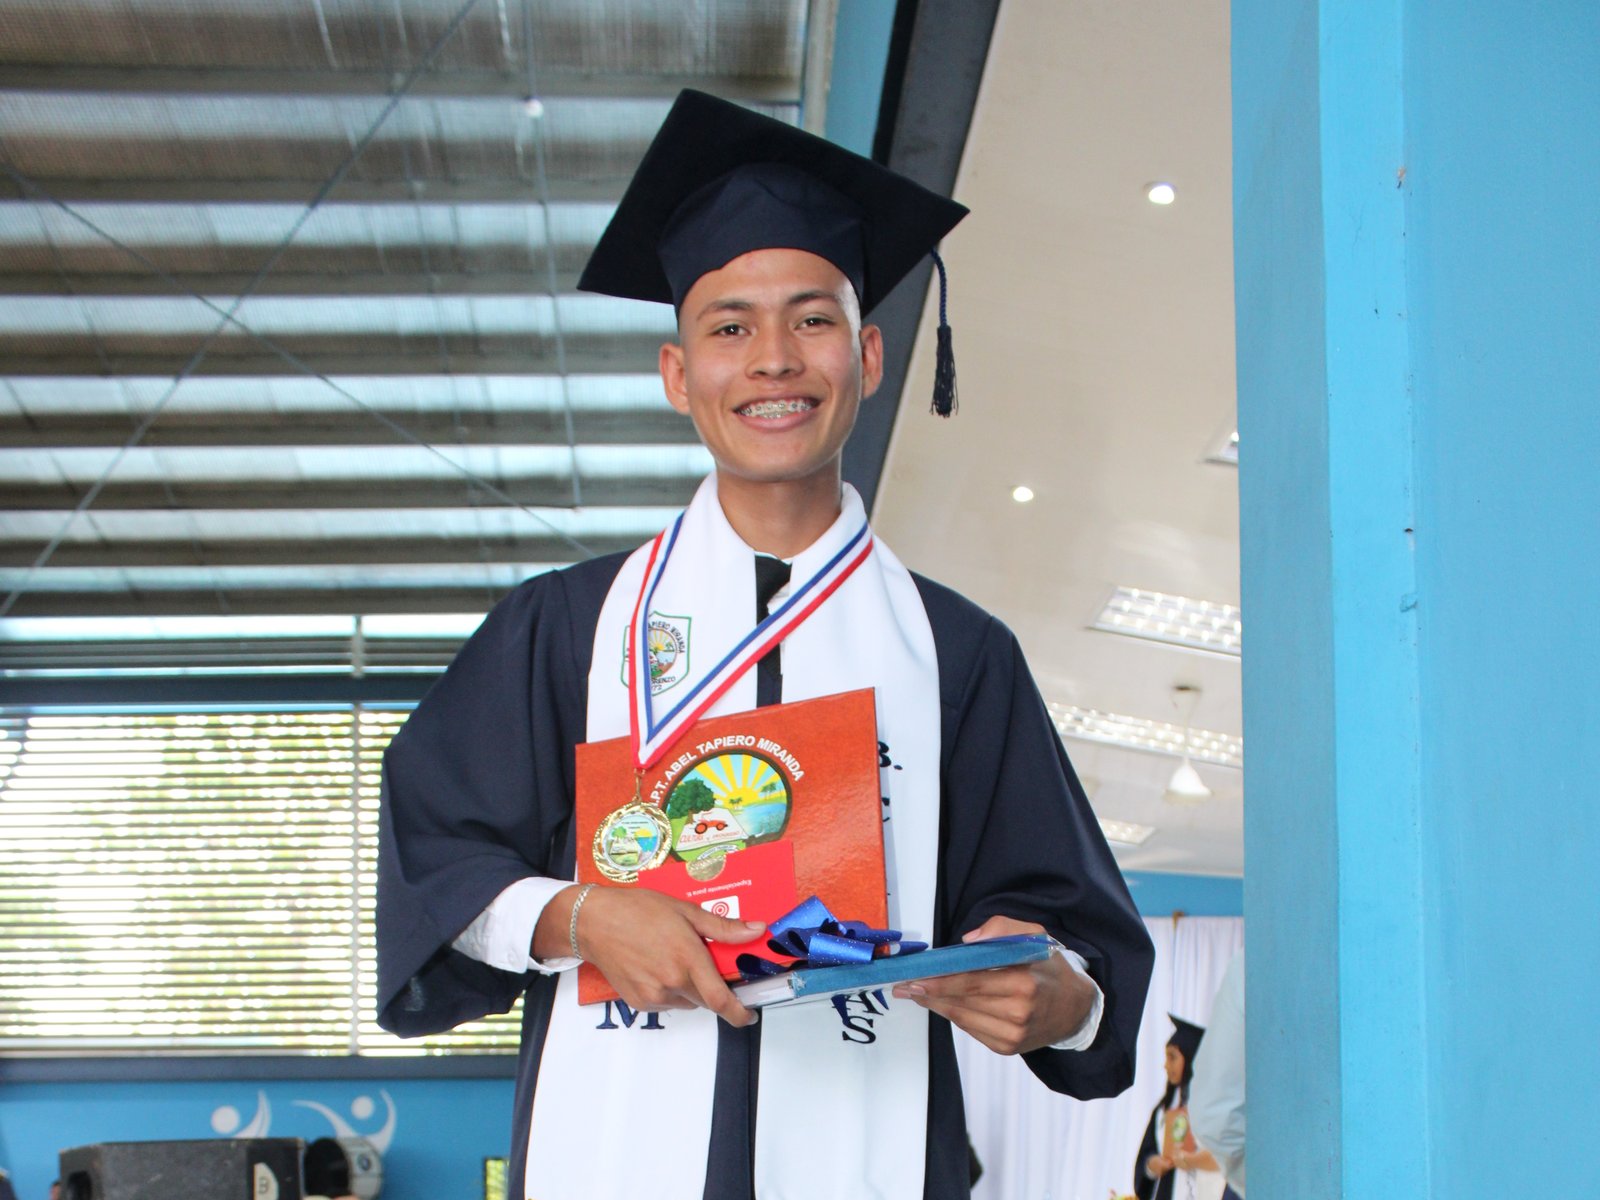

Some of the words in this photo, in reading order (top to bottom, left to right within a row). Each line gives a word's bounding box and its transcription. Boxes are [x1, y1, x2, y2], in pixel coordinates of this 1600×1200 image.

[665, 751, 697, 782] ABEL
[696, 735, 756, 755] TAPIERO
[757, 738, 804, 782] MIRANDA
[692, 888, 707, 896] para
[707, 879, 752, 893] Especialmente
